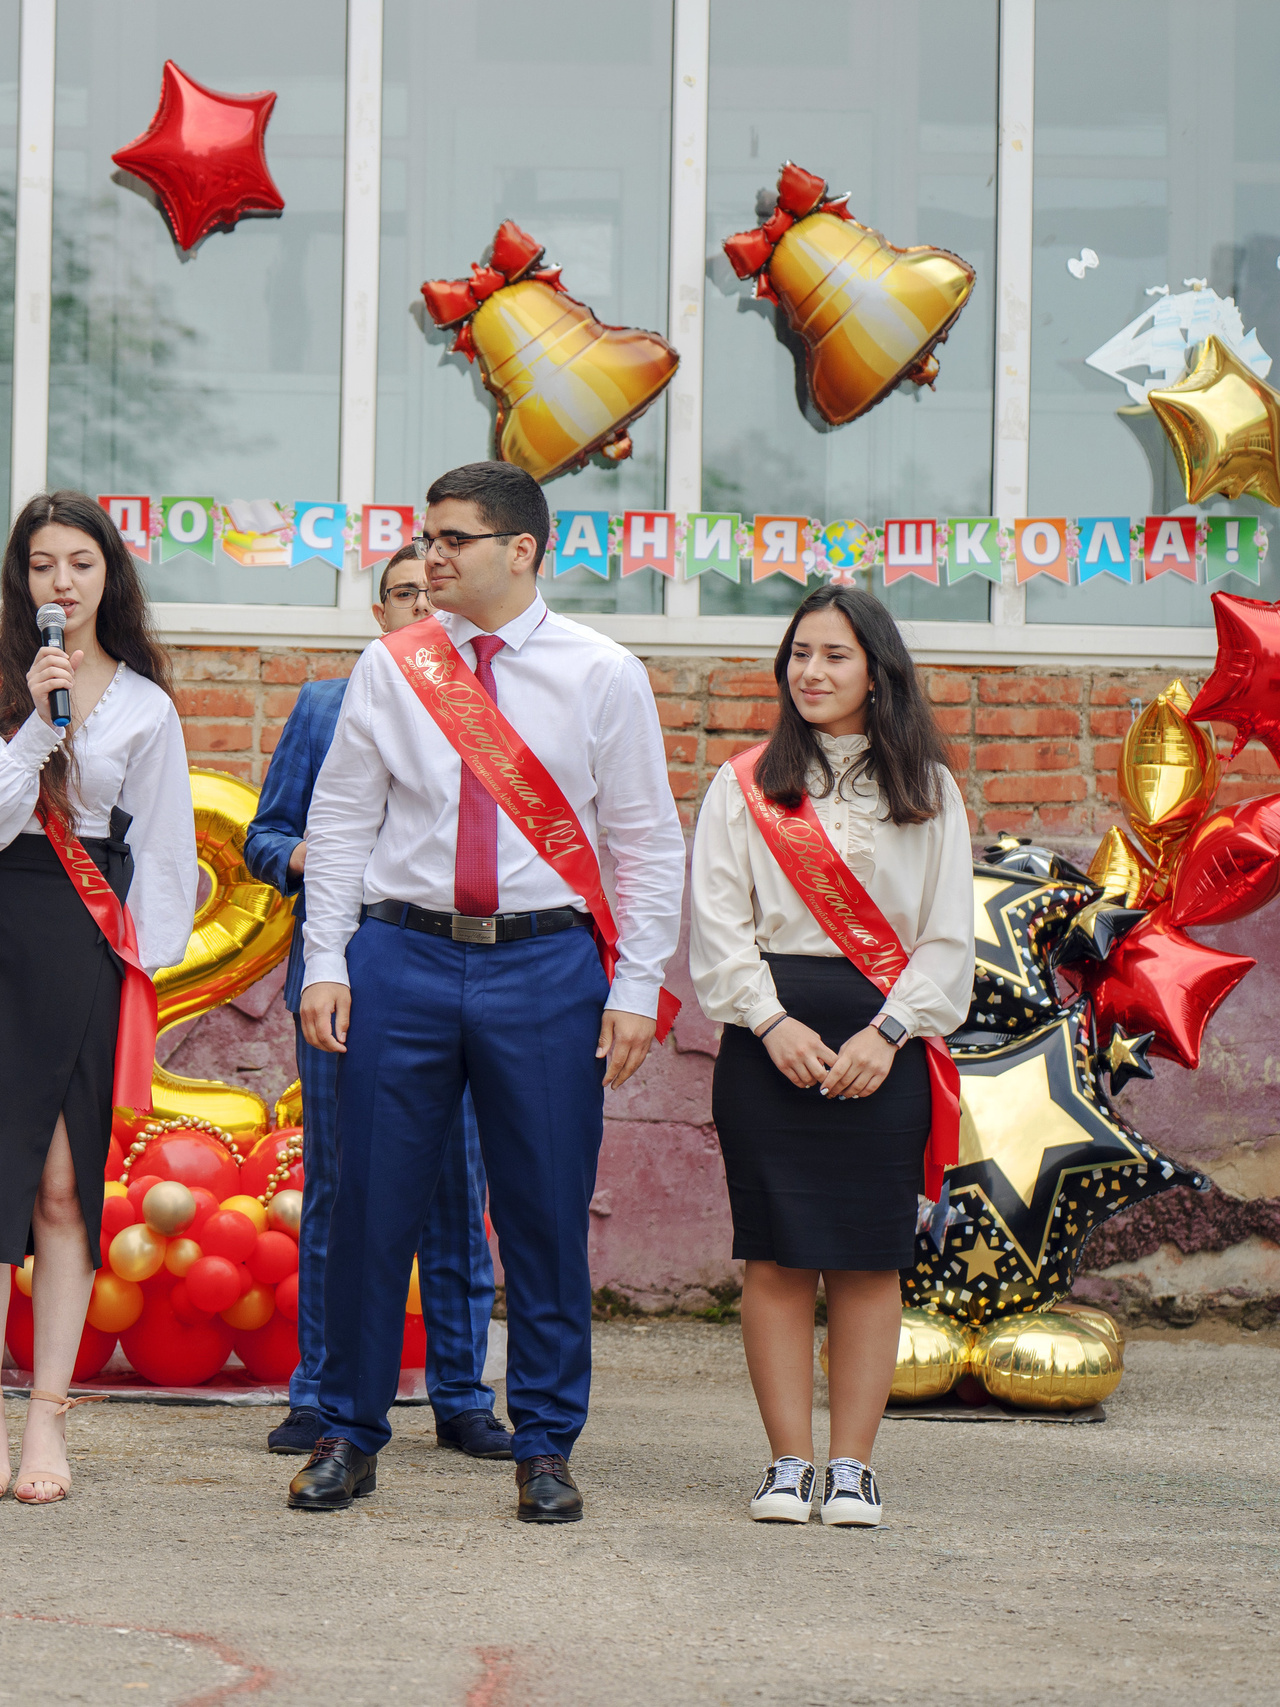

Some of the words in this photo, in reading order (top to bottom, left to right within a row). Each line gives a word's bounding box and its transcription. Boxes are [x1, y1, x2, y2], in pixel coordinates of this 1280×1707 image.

[109, 498, 209, 547] ДО
[299, 505, 817, 573] СВАНИЯ,
[887, 520, 1240, 567] ШКОЛА!
[435, 680, 546, 810] Выпускник
[519, 806, 585, 860] 2021
[469, 754, 500, 792] Республика
[497, 790, 521, 816] Адыгея
[776, 816, 879, 946] Выпускник
[805, 893, 838, 932] Республика
[834, 930, 858, 954] Адыгея
